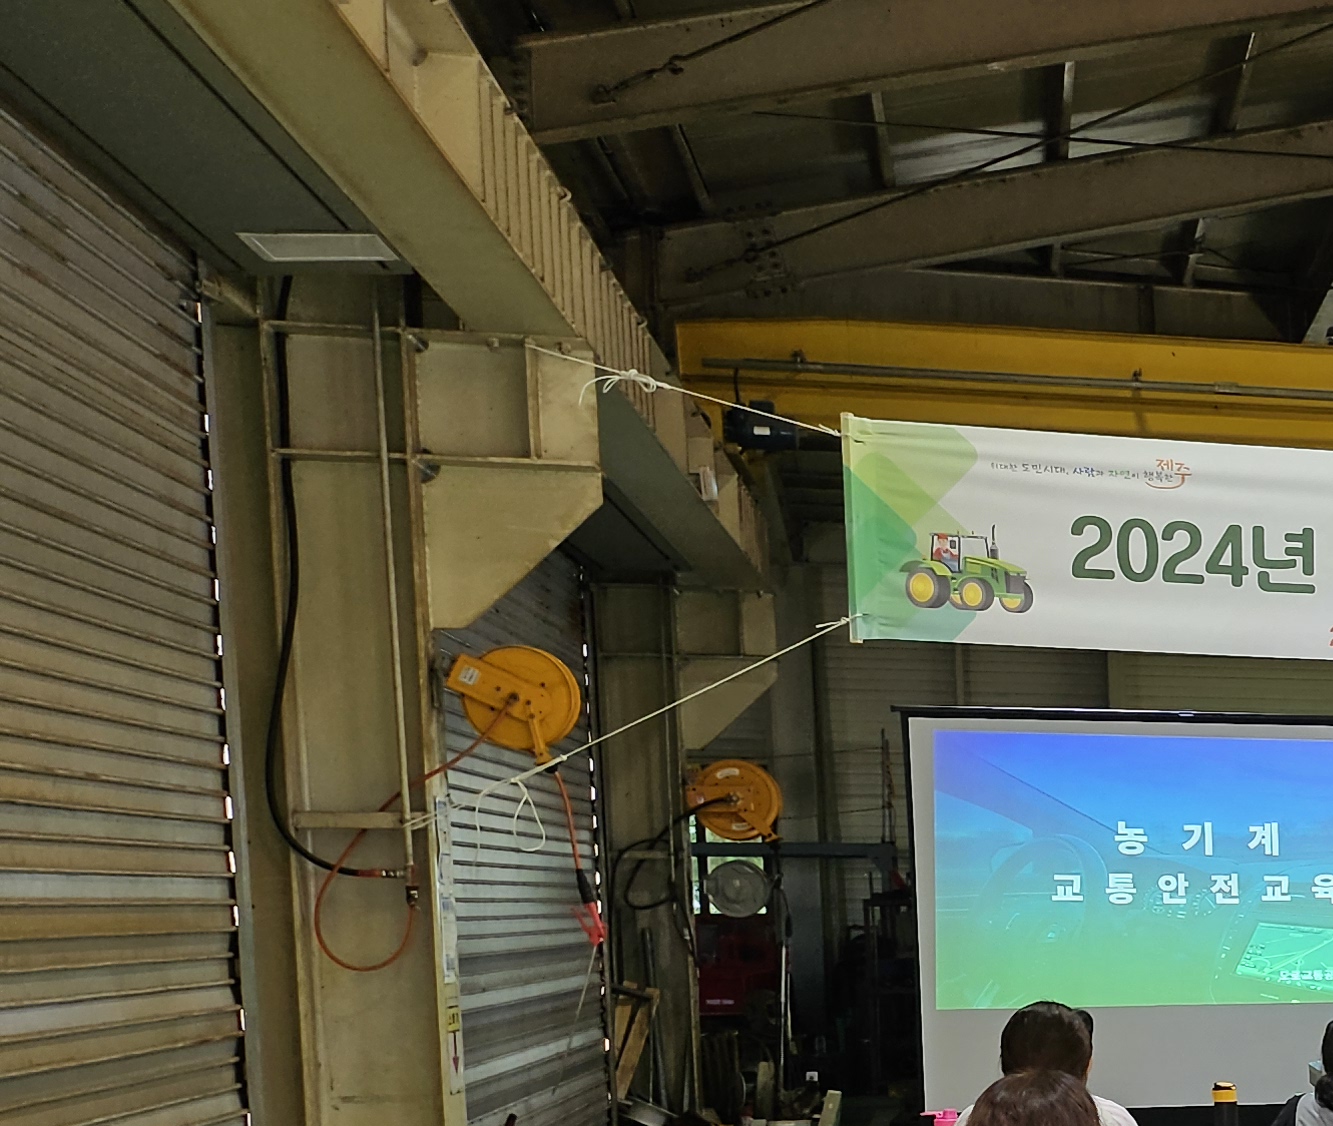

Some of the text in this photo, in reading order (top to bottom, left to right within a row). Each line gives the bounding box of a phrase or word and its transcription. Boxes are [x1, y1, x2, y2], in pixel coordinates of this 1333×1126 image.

[1073, 466, 1104, 478] 사람과
[1108, 469, 1139, 480] 자연이
[1156, 458, 1192, 486] 제주
[1069, 515, 1317, 595] 2024년
